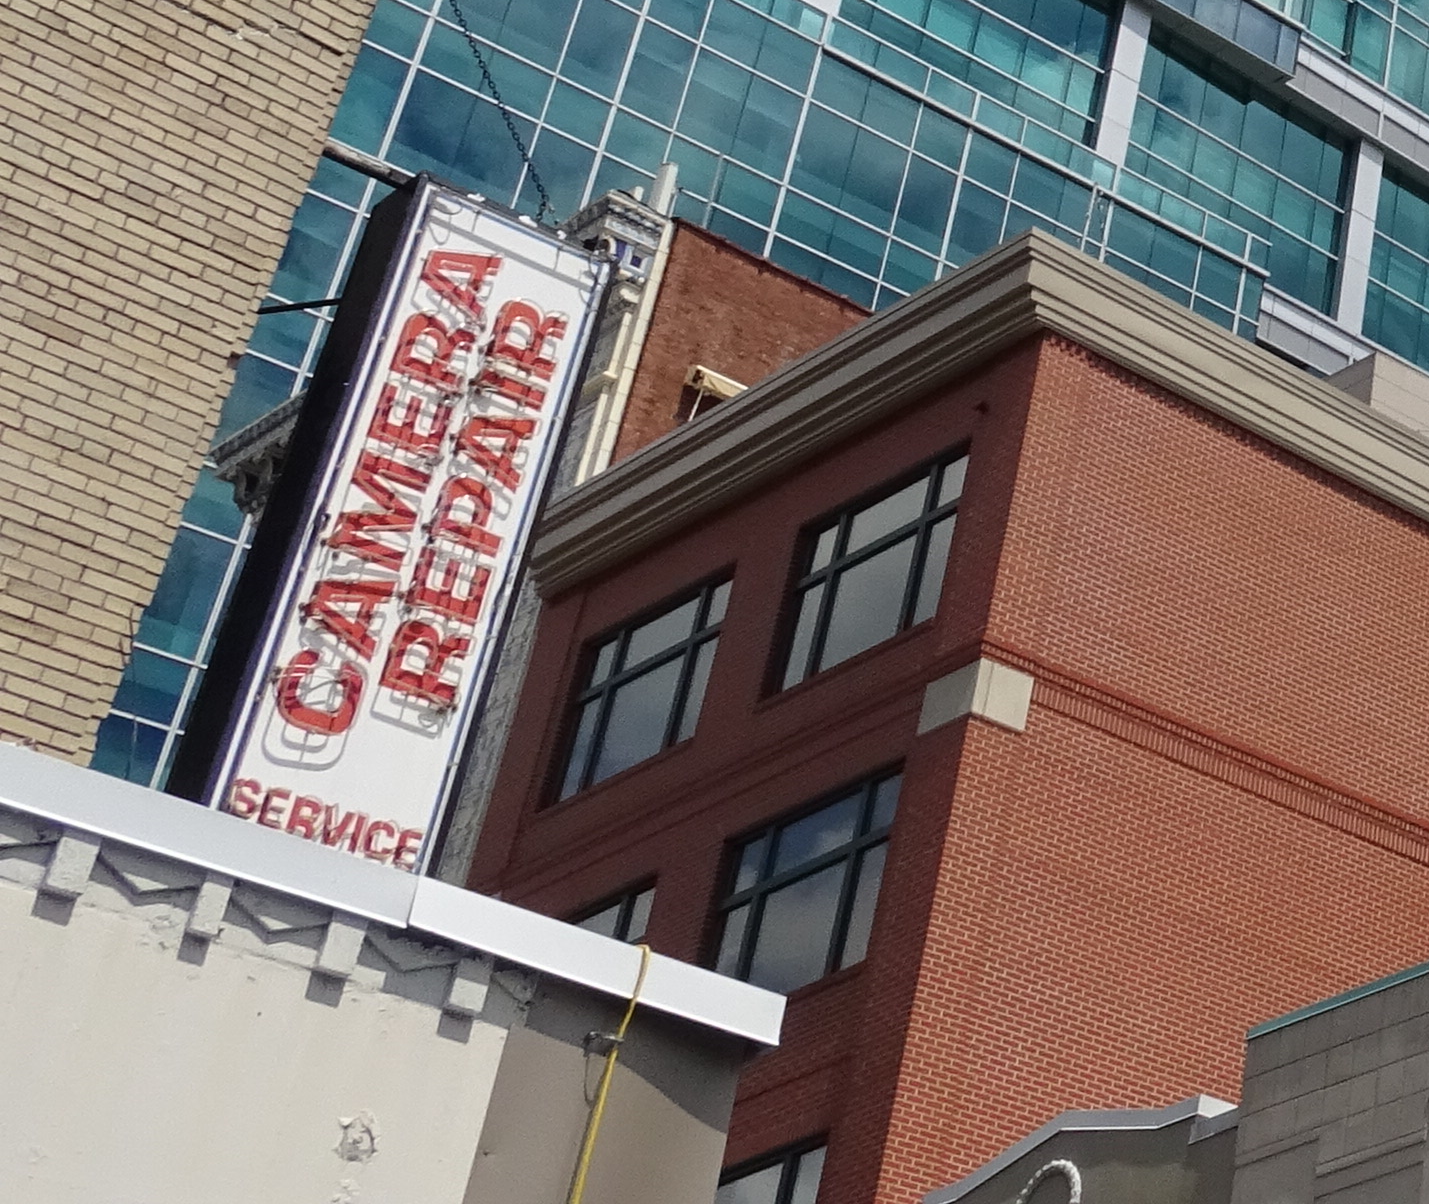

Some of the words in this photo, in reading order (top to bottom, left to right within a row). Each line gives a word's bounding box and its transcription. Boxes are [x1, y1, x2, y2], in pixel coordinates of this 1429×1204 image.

[276, 249, 503, 736] CAMERA
[378, 298, 570, 708] REPAIR
[230, 777, 424, 873] SERVICE
